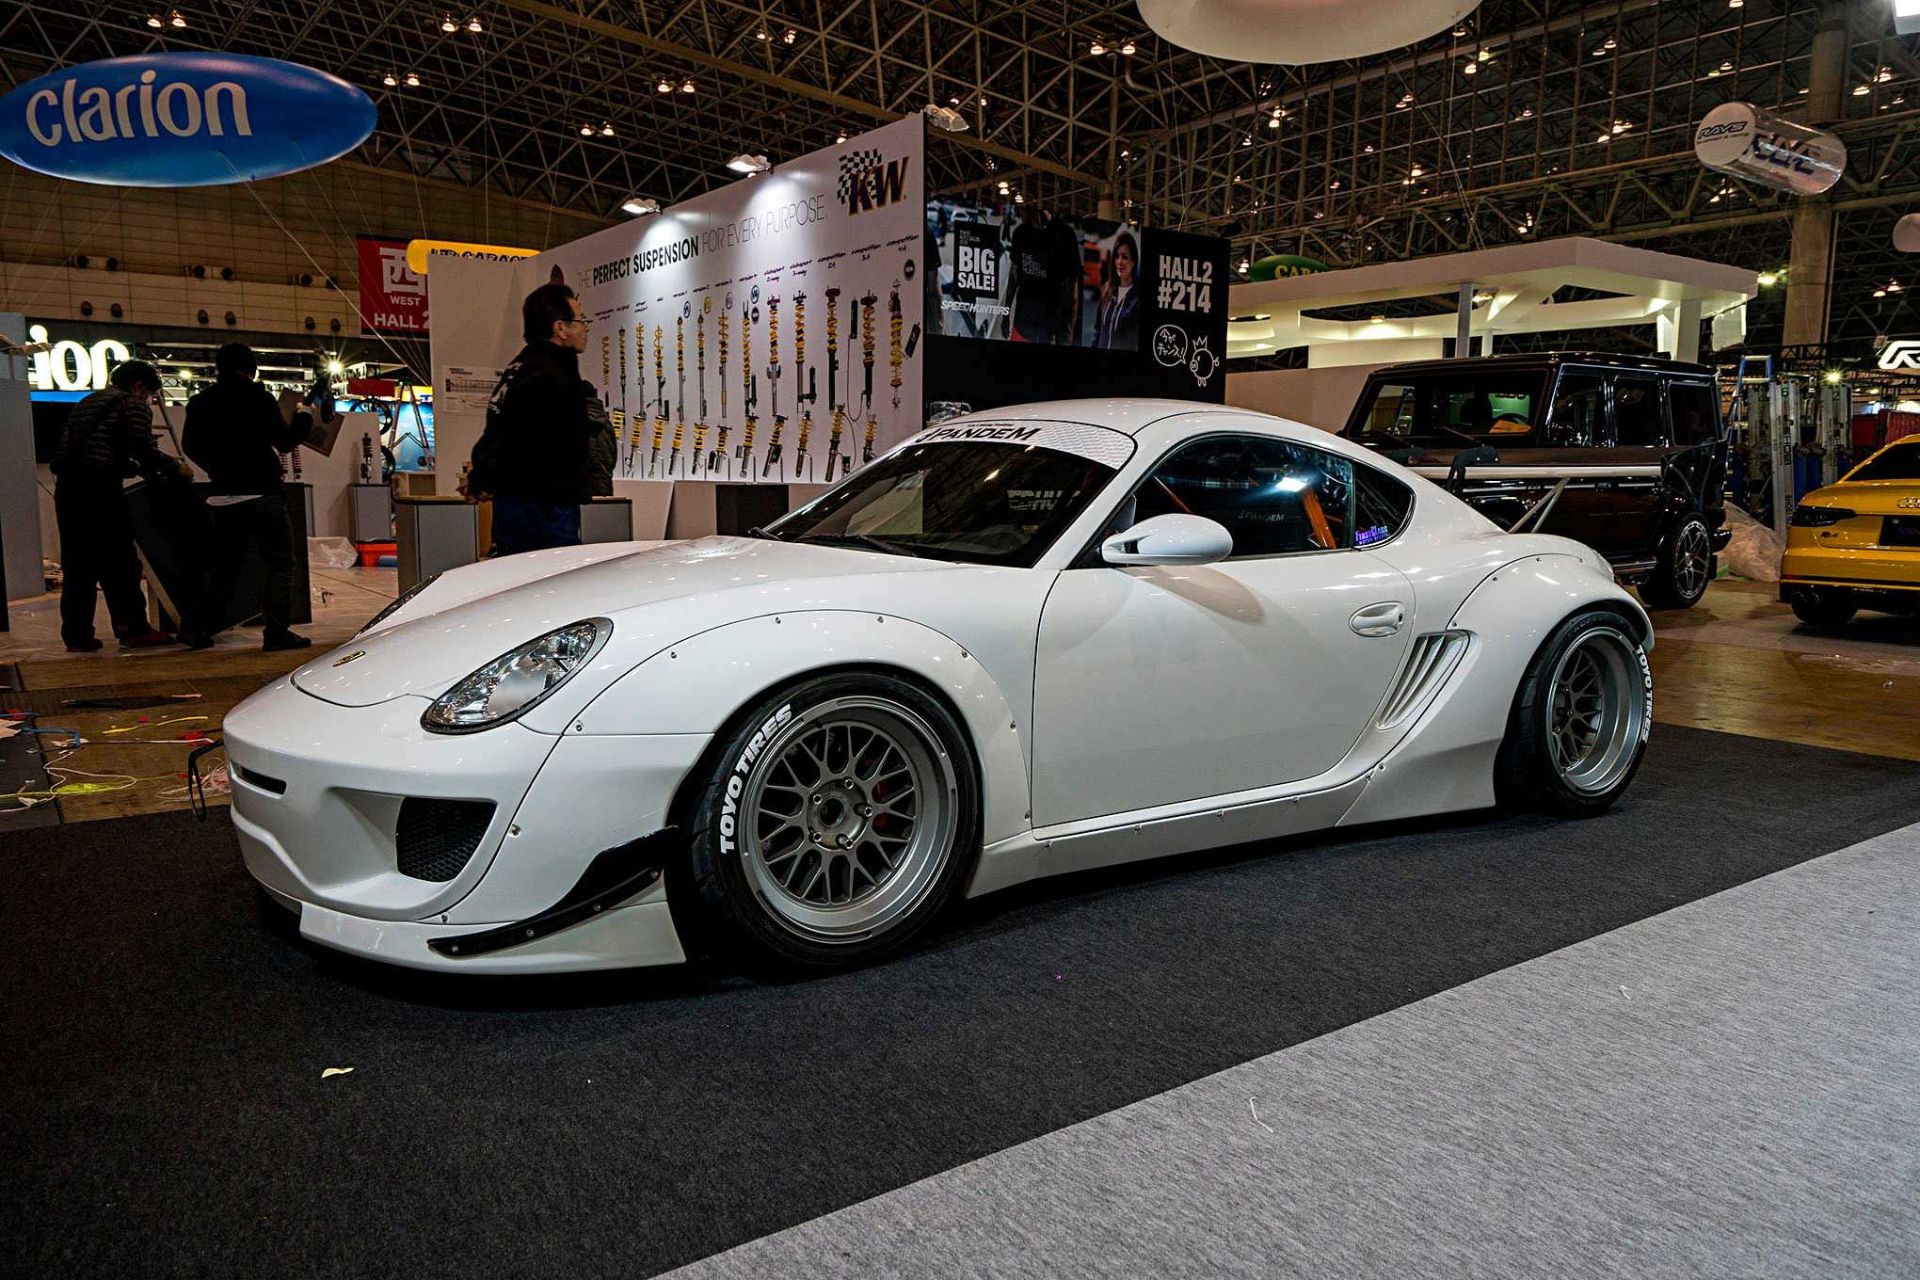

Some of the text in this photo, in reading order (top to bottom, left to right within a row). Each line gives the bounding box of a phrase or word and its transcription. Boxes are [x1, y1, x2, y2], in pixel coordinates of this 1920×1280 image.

[849, 156, 910, 216] KW
[593, 256, 631, 286] PERFECT
[633, 236, 699, 274] SUSPENSION
[702, 227, 725, 254] FOR
[727, 218, 762, 247] EVERY
[959, 246, 995, 275] BIG
[958, 272, 995, 292] SALE!
[1157, 280, 1212, 313] #214
[390, 295, 420, 306] WEST
[374, 313, 418, 328] HALL
[1636, 644, 1653, 743] TOYO TIRES
[720, 703, 793, 854] TOYO TIRES
